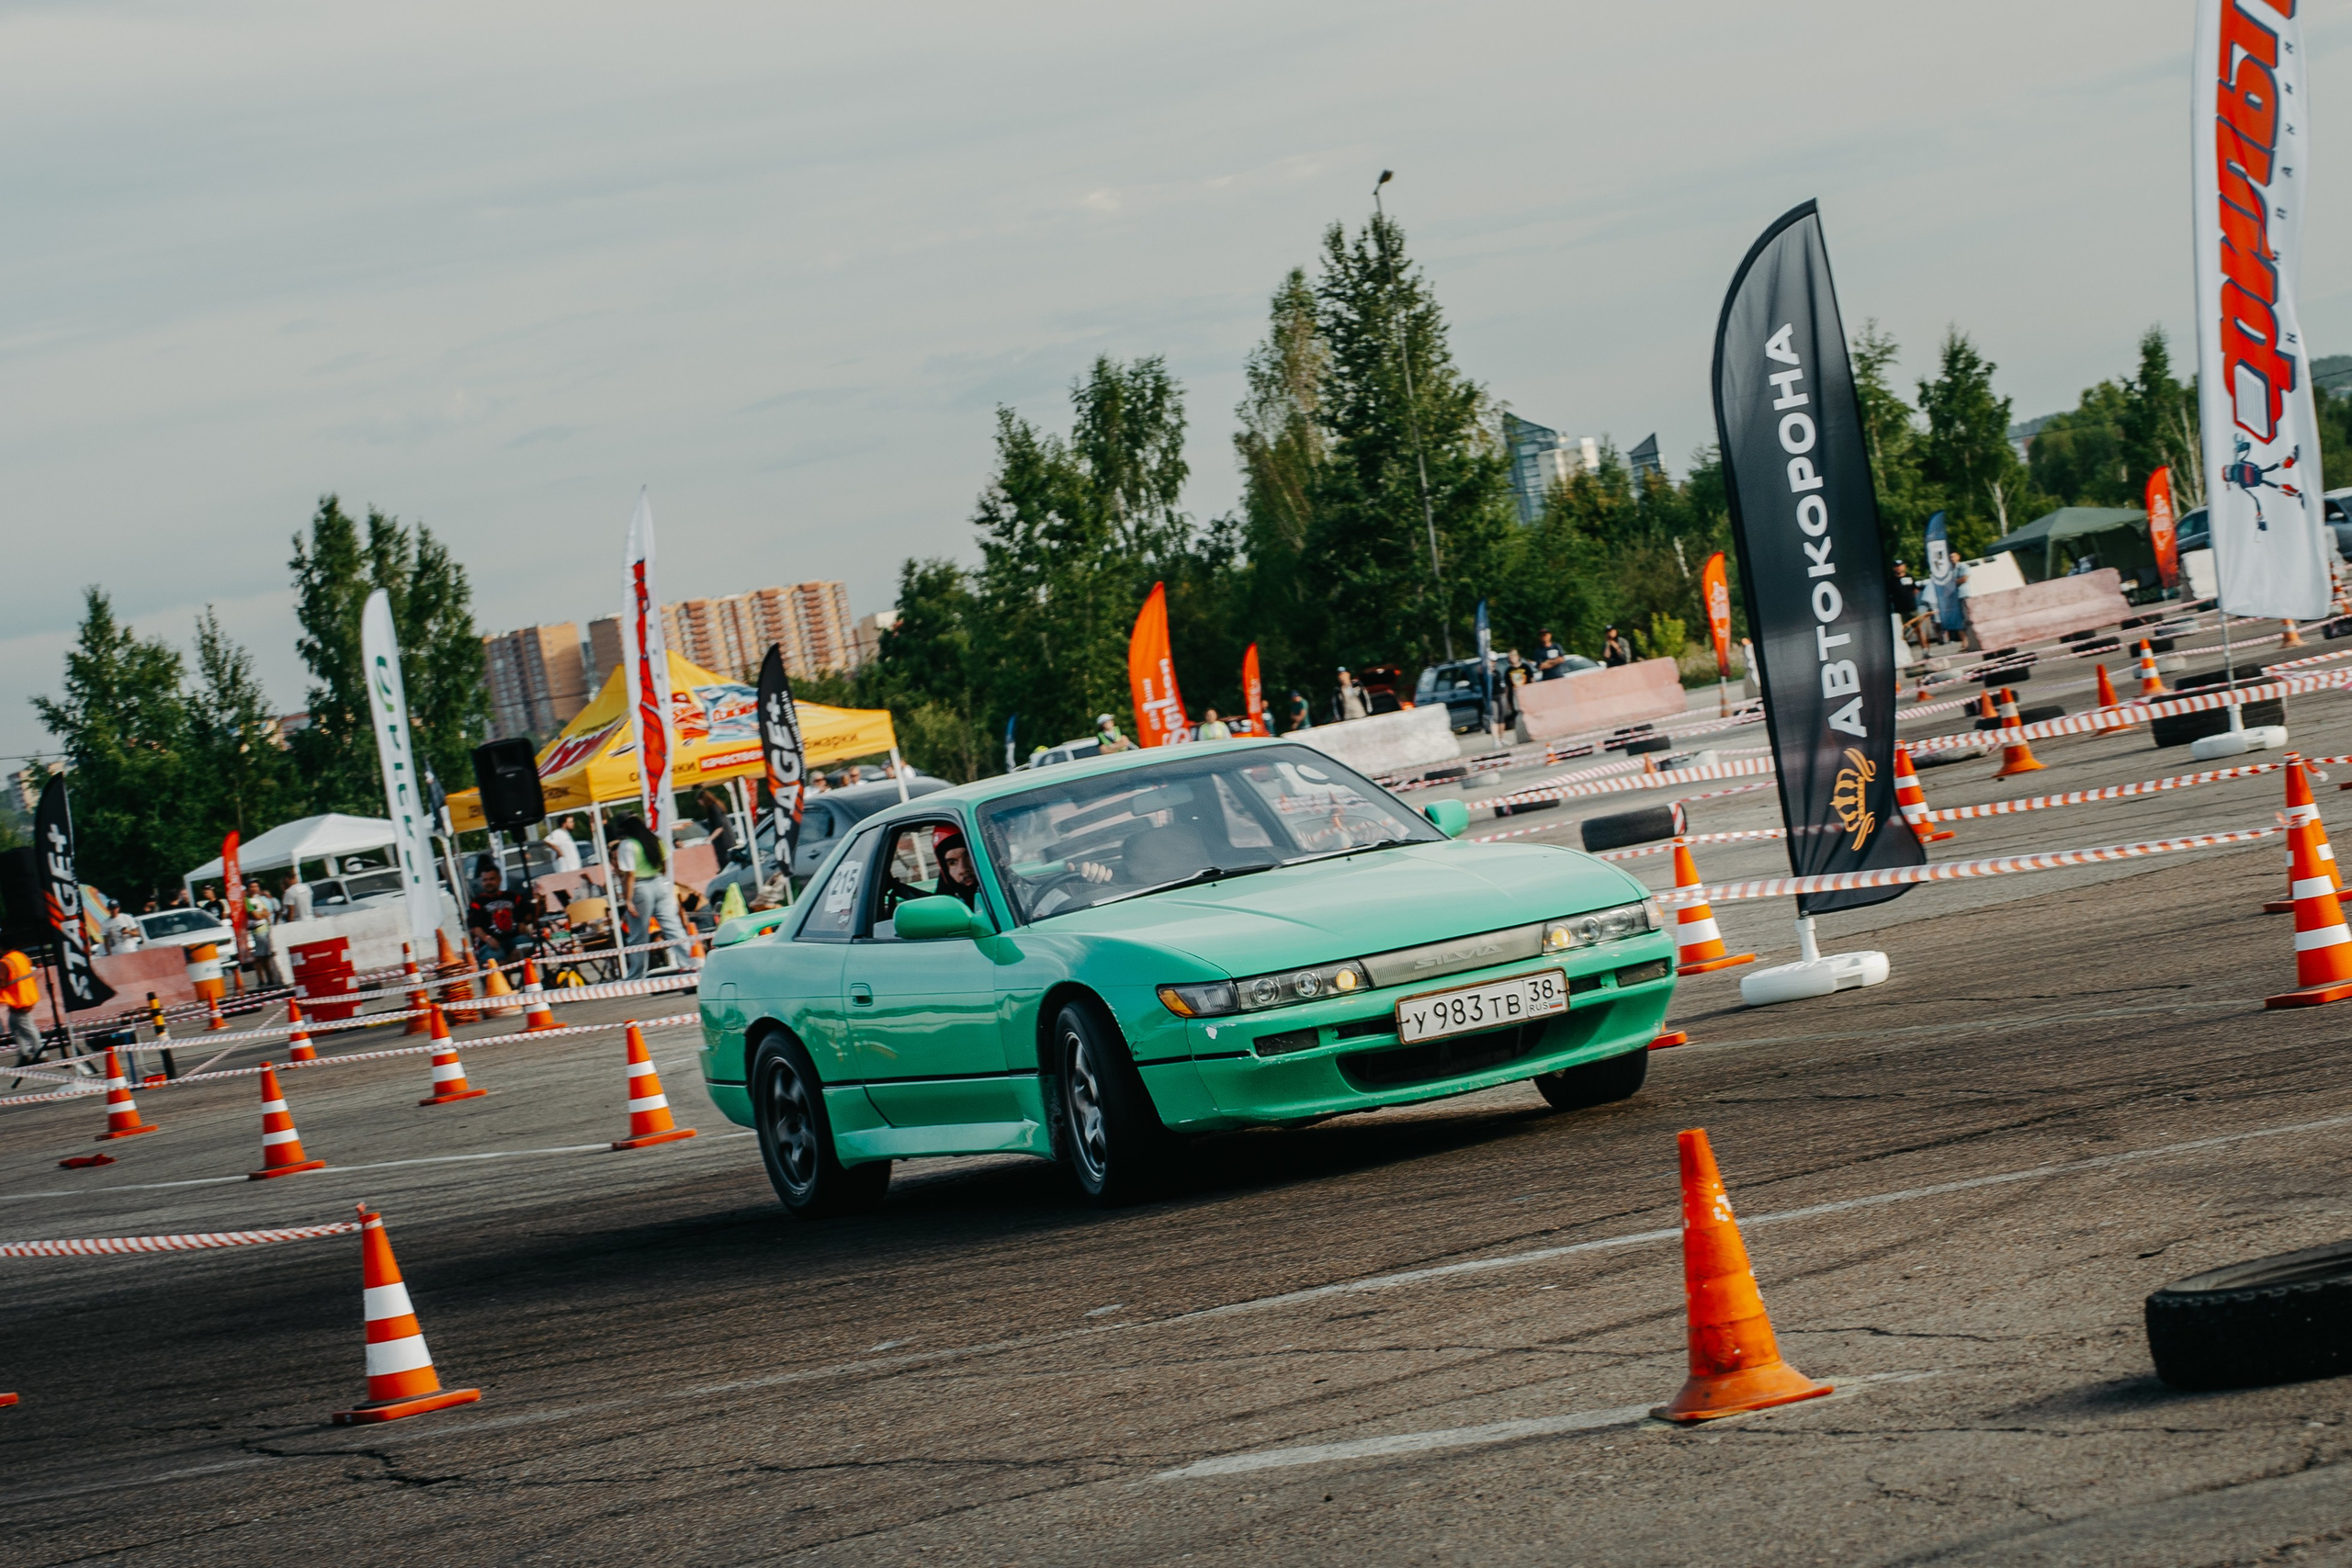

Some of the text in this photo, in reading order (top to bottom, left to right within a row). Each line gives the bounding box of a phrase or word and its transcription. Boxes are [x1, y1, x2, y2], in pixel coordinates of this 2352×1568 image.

[1764, 322, 1868, 739] АВТОКОРОНА
[765, 693, 800, 867] STAGE+
[47, 823, 93, 1000] STAGE+
[831, 868, 858, 896] 215
[1528, 978, 1555, 1002] 38
[1529, 1001, 1549, 1012] RUS
